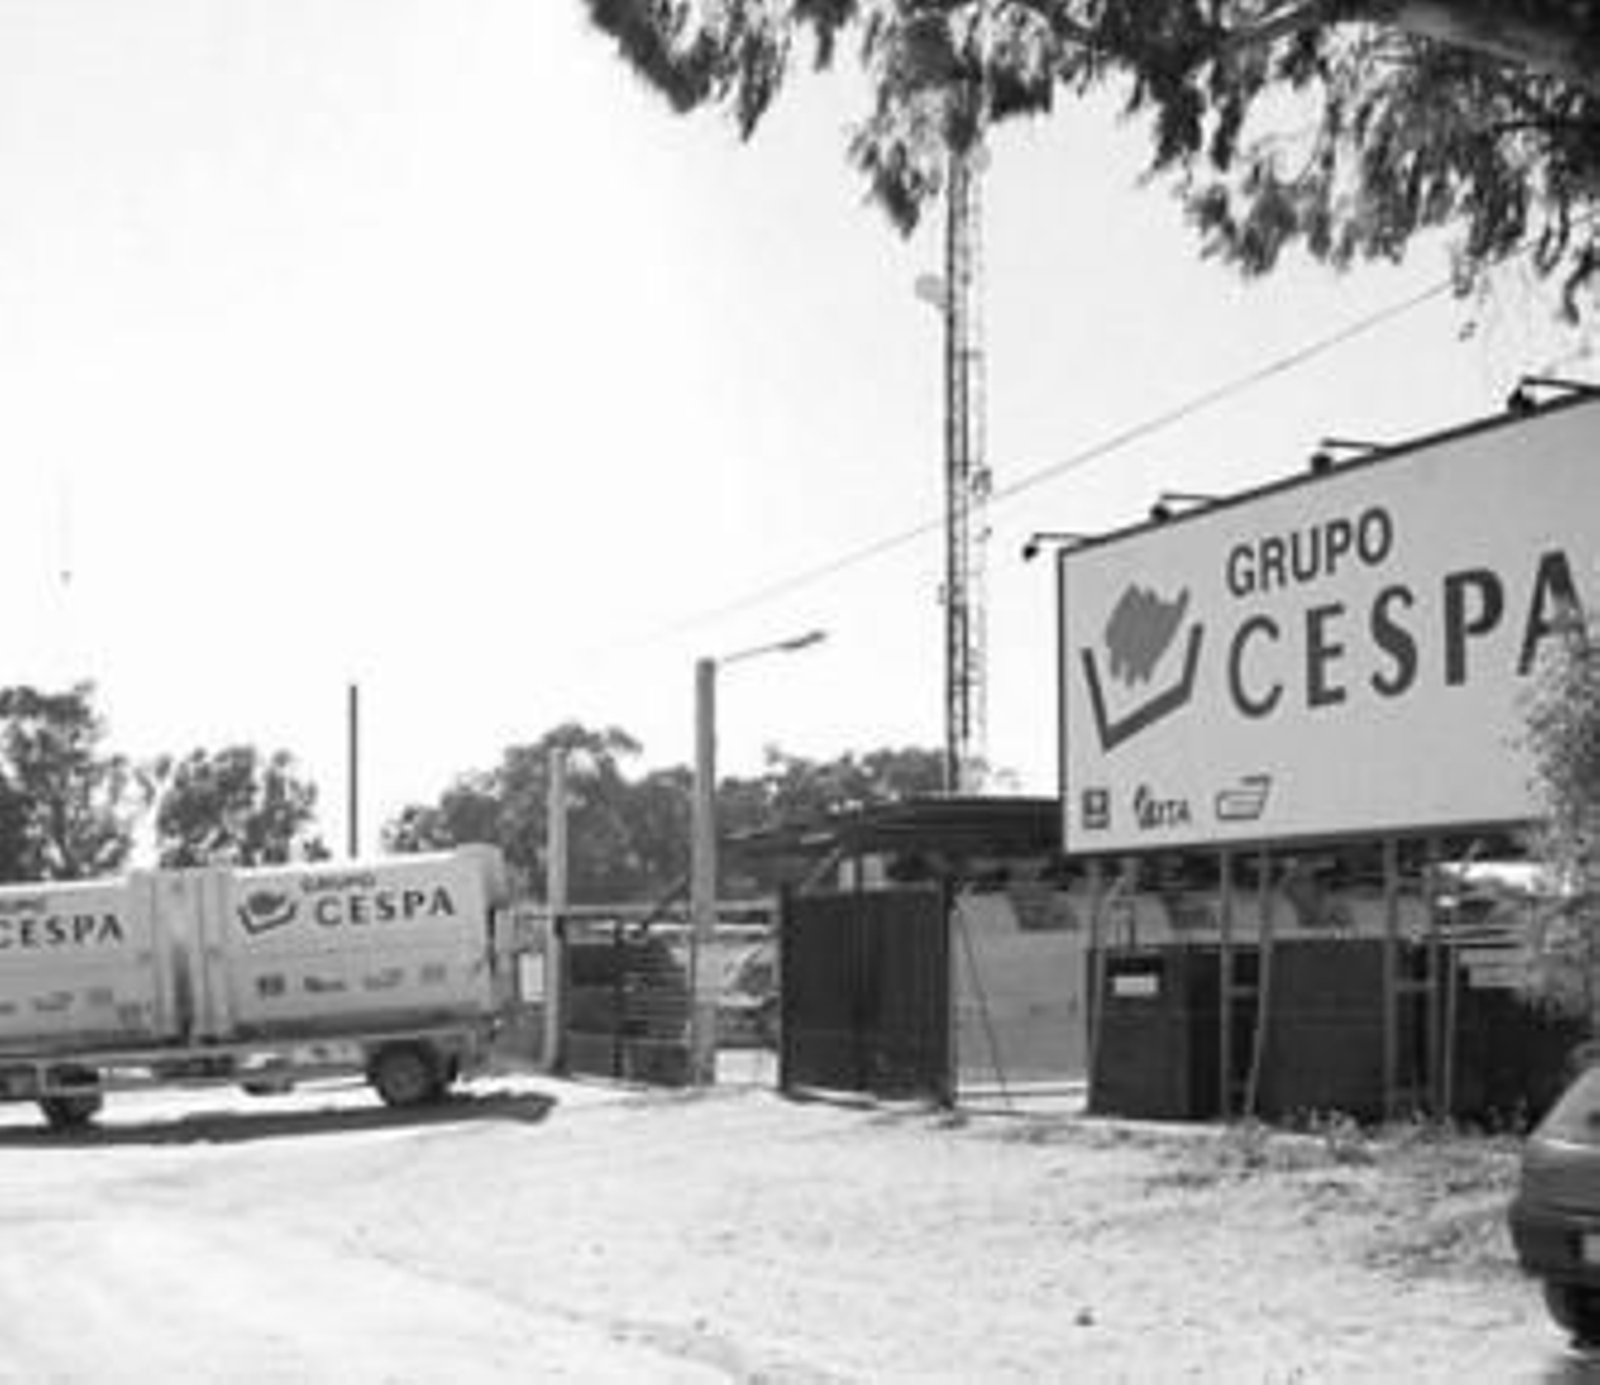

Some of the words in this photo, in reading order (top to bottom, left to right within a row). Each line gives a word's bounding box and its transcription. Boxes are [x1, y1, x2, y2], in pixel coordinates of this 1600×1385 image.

[1226, 506, 1394, 598] GRUPO
[1228, 550, 1587, 719] CESPA
[314, 886, 456, 926] CESPA
